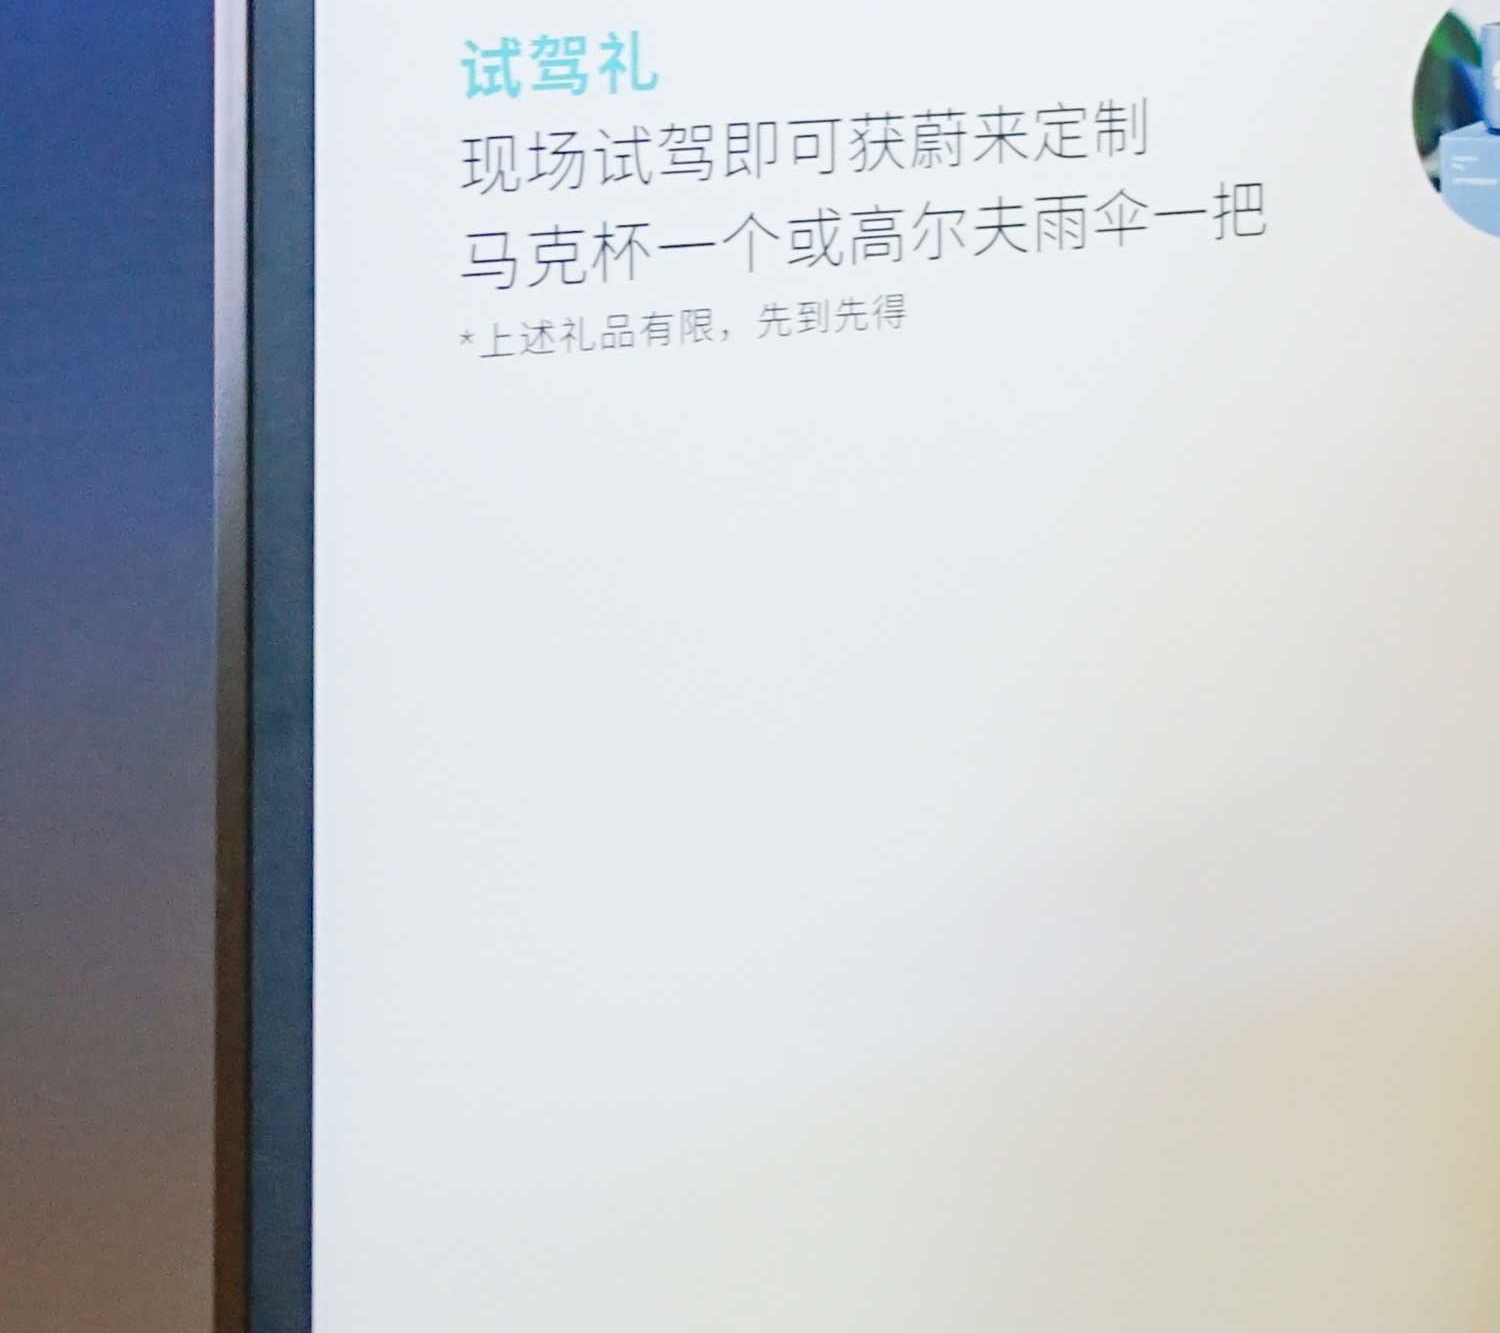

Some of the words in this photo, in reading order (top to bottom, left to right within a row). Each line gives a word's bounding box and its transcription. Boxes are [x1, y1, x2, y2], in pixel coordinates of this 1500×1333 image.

[460, 30, 660, 99] 试驾礼
[461, 96, 1147, 197] 现场试驾即可获蔚来定制
[461, 179, 1266, 295] 马克杯一个或高尔夫雨伞一把
